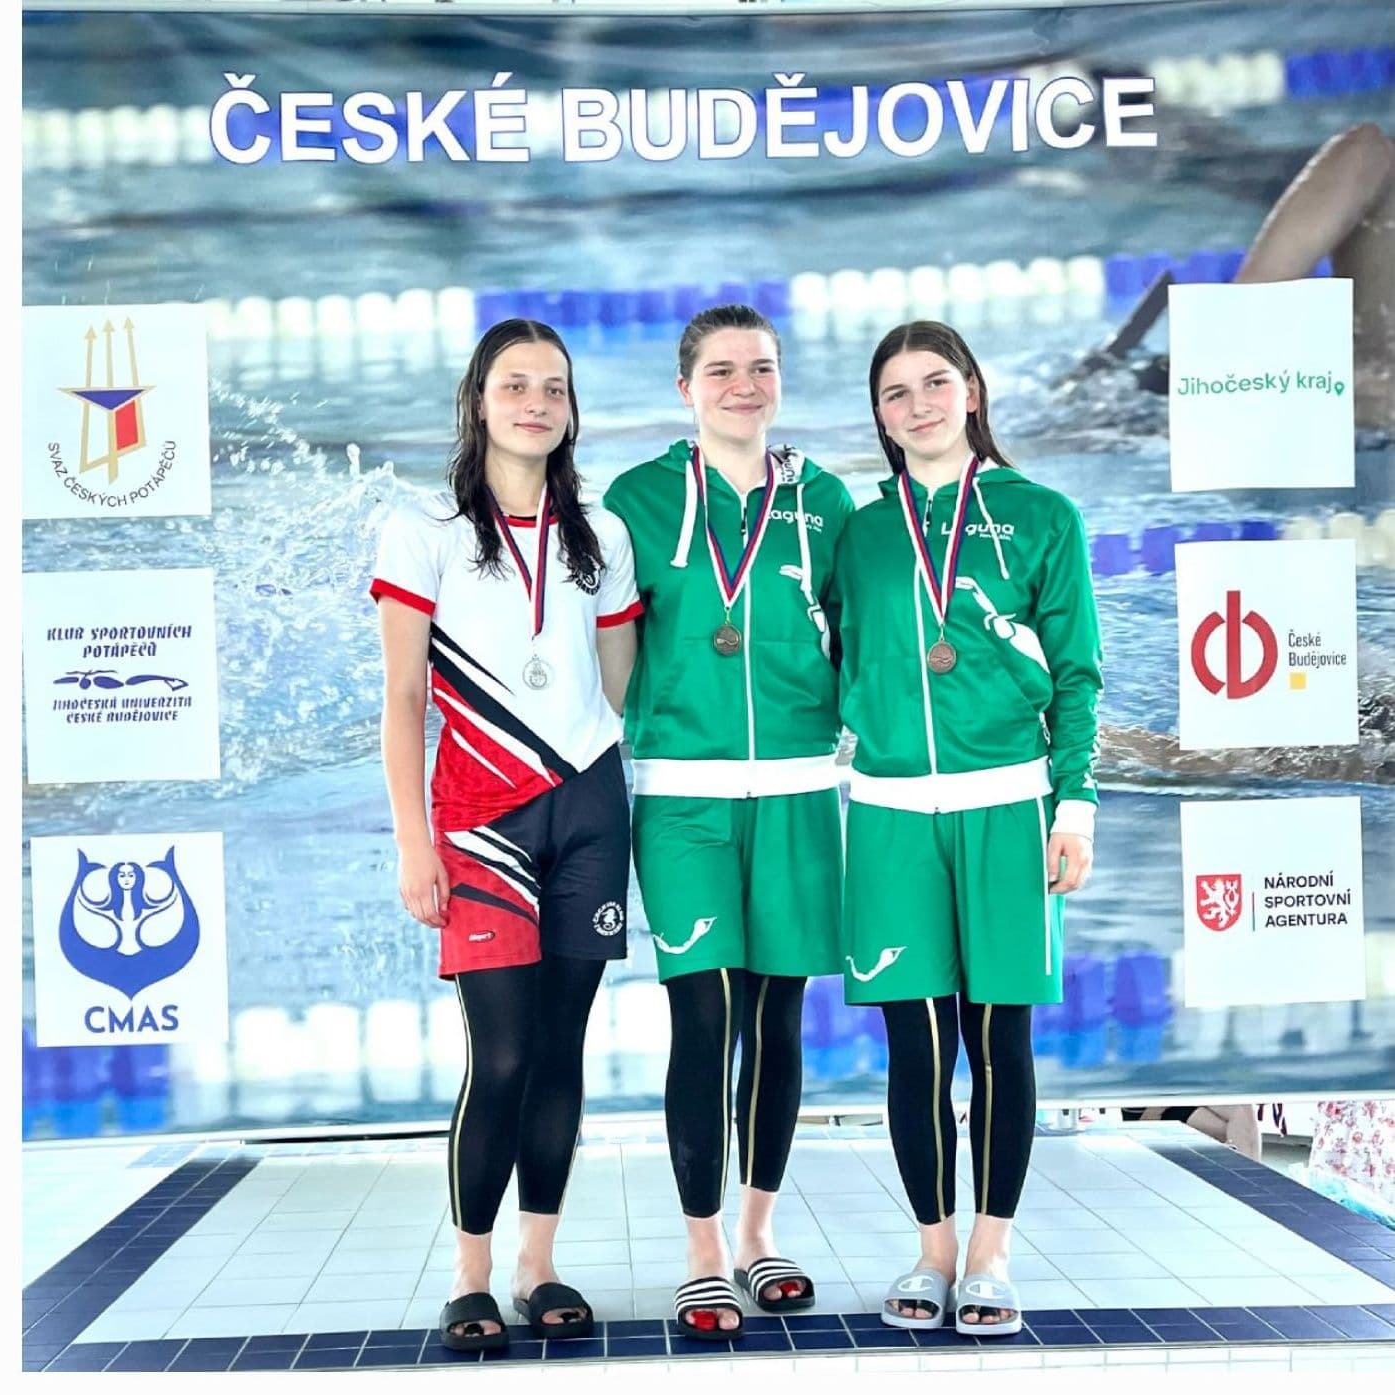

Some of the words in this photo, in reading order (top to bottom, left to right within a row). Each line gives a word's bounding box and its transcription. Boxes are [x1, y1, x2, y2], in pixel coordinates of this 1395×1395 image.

[209, 71, 531, 164] ČESKÉ
[562, 73, 1158, 162] BUDĚJOVICE
[1178, 369, 1290, 395] Jihočeský
[1296, 371, 1332, 393] kraj
[48, 442, 68, 478] SVAZ
[63, 475, 127, 507] ČESKÝCH
[941, 522, 1014, 536] Lguna
[47, 627, 84, 641] KLUB
[90, 624, 192, 640] SPORTOVNÍCH
[1288, 629, 1322, 647] České
[1288, 651, 1347, 669] Budějovice
[122, 696, 192, 708] UNIVERZITA
[1264, 870, 1334, 889] NÁRODNÍ
[1264, 888, 1351, 909] SPORTOVNÍ
[1265, 912, 1348, 928] AGENTURA
[84, 1004, 179, 1034] CMAS
